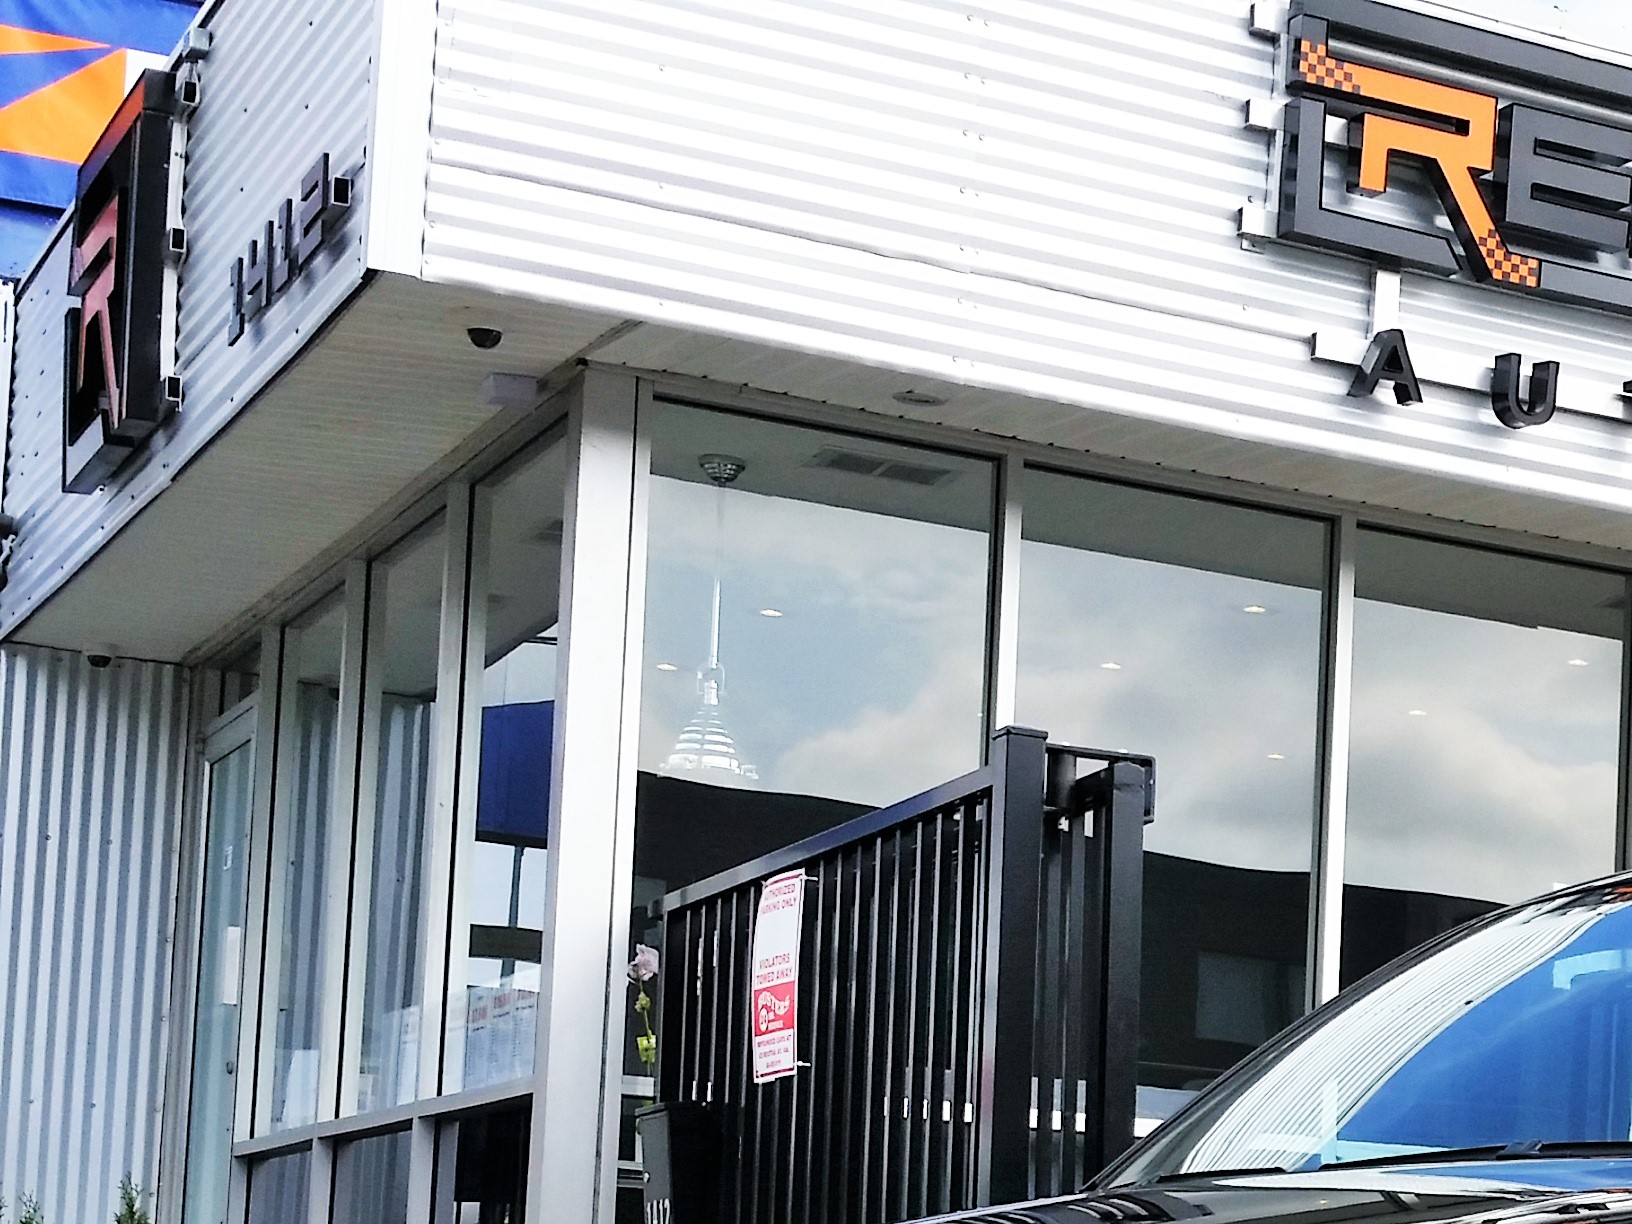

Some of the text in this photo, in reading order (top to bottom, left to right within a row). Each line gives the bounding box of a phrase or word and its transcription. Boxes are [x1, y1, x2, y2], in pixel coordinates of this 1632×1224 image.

[759, 953, 790, 969] VIOLATORS
[756, 967, 793, 986] TOWED AWAY
